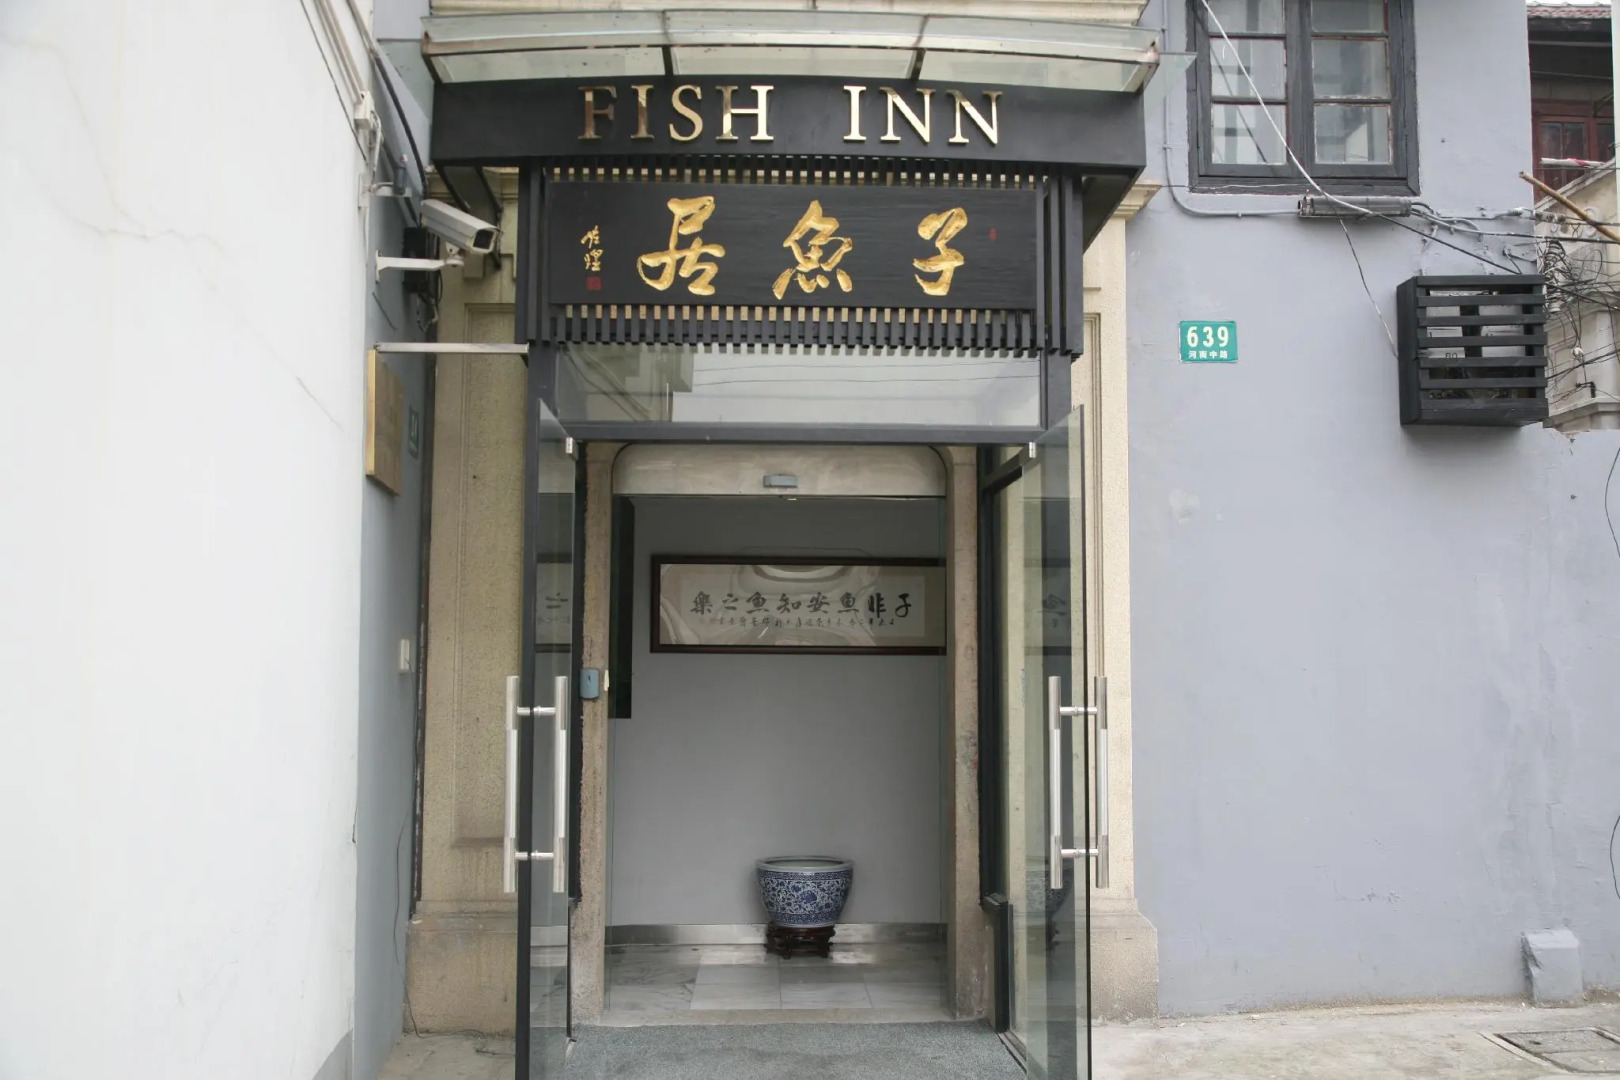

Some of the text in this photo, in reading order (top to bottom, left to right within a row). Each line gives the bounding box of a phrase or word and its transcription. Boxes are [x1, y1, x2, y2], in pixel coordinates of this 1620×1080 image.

[578, 85, 1003, 146] FISH INN
[1187, 326, 1229, 347] 639
